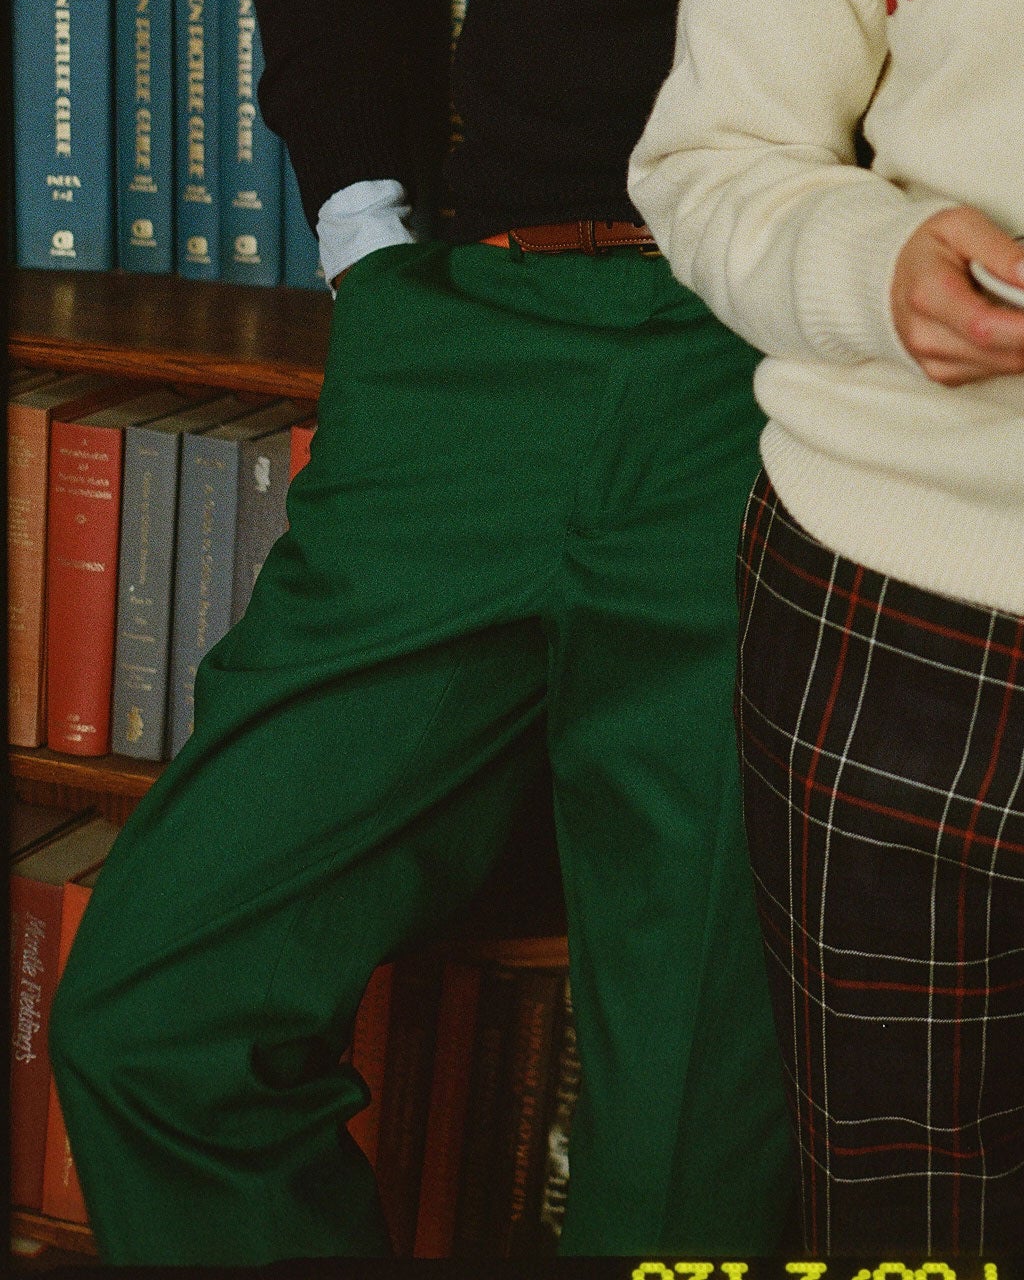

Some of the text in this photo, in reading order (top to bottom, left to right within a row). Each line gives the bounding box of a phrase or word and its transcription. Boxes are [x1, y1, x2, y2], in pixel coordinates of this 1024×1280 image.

[55, 9, 72, 95] PICTURE
[135, 18, 151, 104] PICTURE
[187, 25, 204, 114] PICTURE
[237, 18, 255, 163] PICTURE GUIDE
[55, 96, 72, 157] GUIDE
[135, 108, 151, 170] GUIDE
[187, 116, 204, 179] GUIDE
[13, 977, 42, 1064] Fielding's
